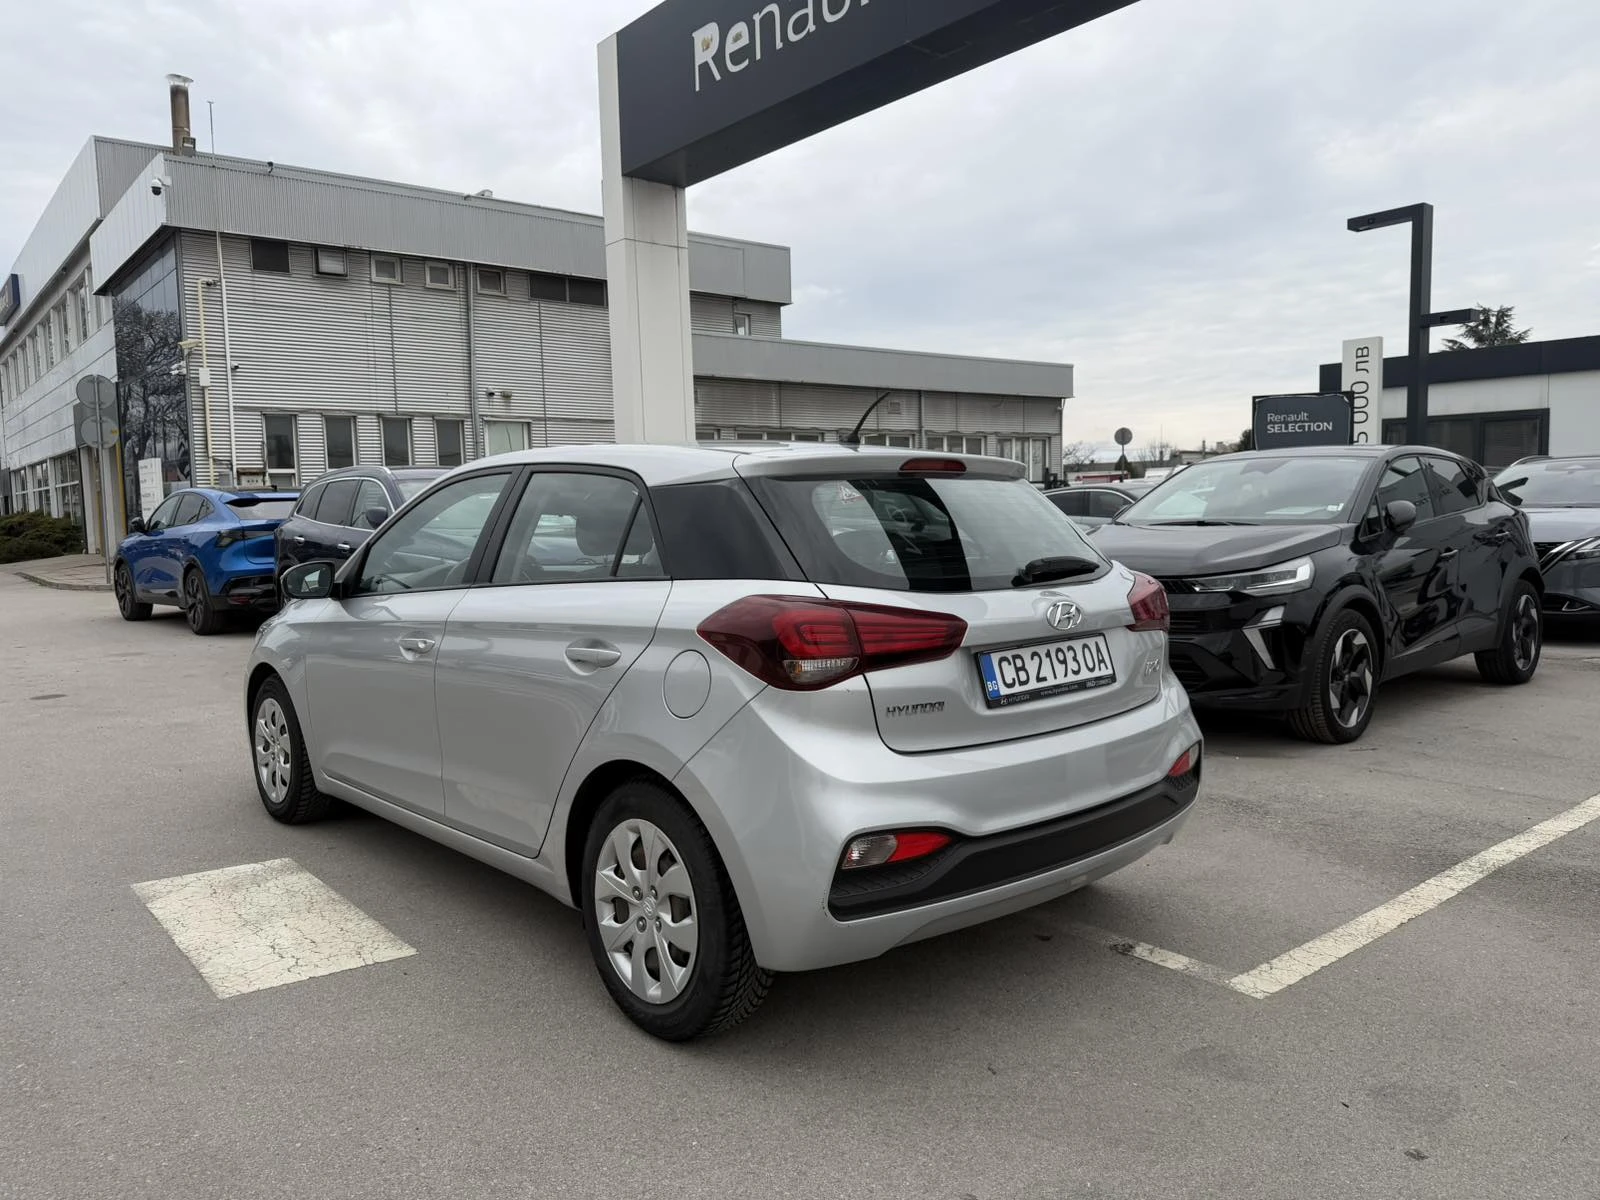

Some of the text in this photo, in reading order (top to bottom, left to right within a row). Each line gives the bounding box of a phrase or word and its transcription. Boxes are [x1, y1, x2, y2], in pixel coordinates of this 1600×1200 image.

[1350, 380, 1369, 424] 000
[1267, 411, 1309, 423] Renault
[1267, 421, 1333, 434] SELECTION
[1030, 645, 1081, 684] 2193
[987, 680, 998, 692] BG
[886, 701, 945, 718] HYUNDAI
